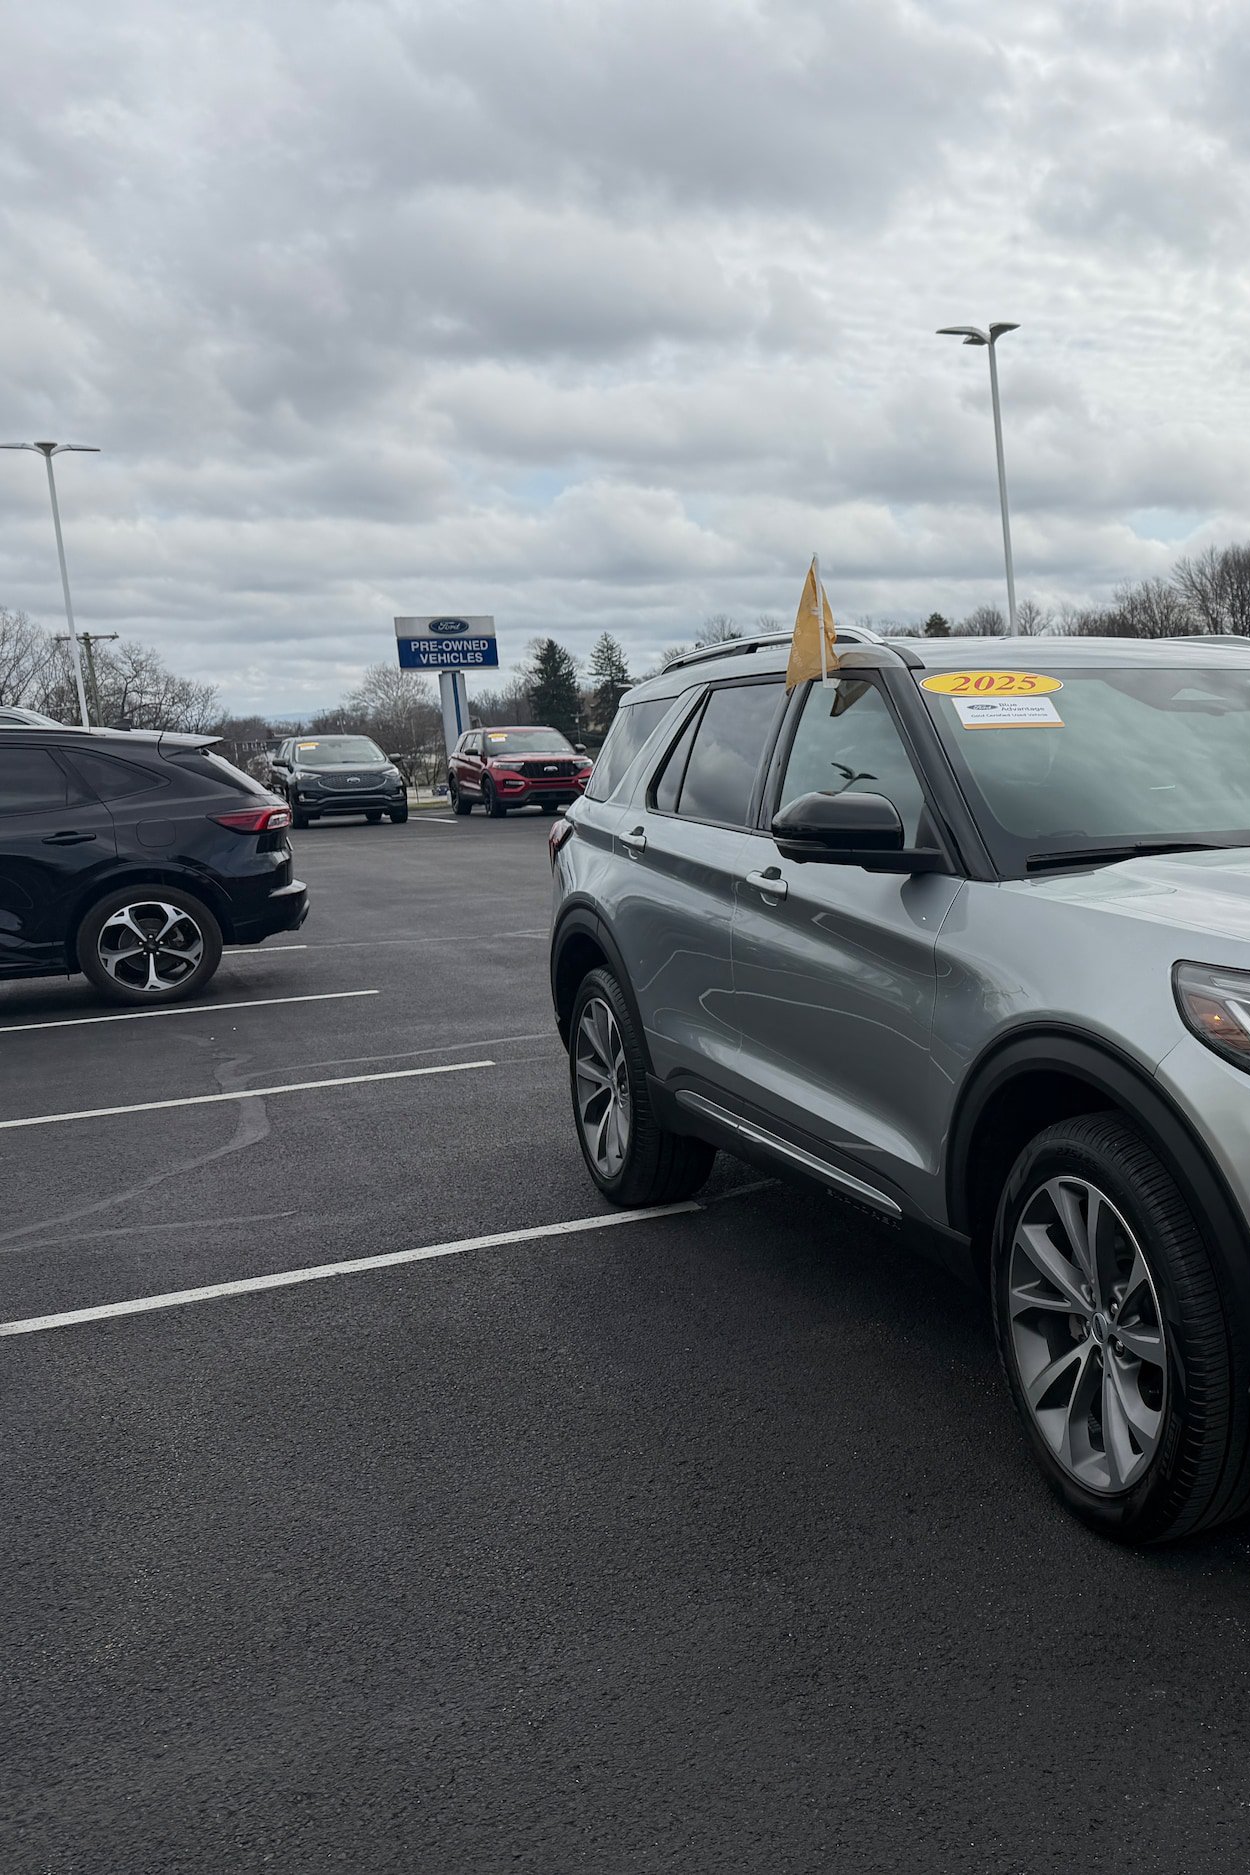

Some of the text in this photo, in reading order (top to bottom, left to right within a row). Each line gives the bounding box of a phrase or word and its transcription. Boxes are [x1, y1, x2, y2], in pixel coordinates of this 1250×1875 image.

[410, 640, 489, 652] PRE-OWNED
[420, 652, 484, 664] VEHICLES
[950, 675, 1040, 692] 2025
